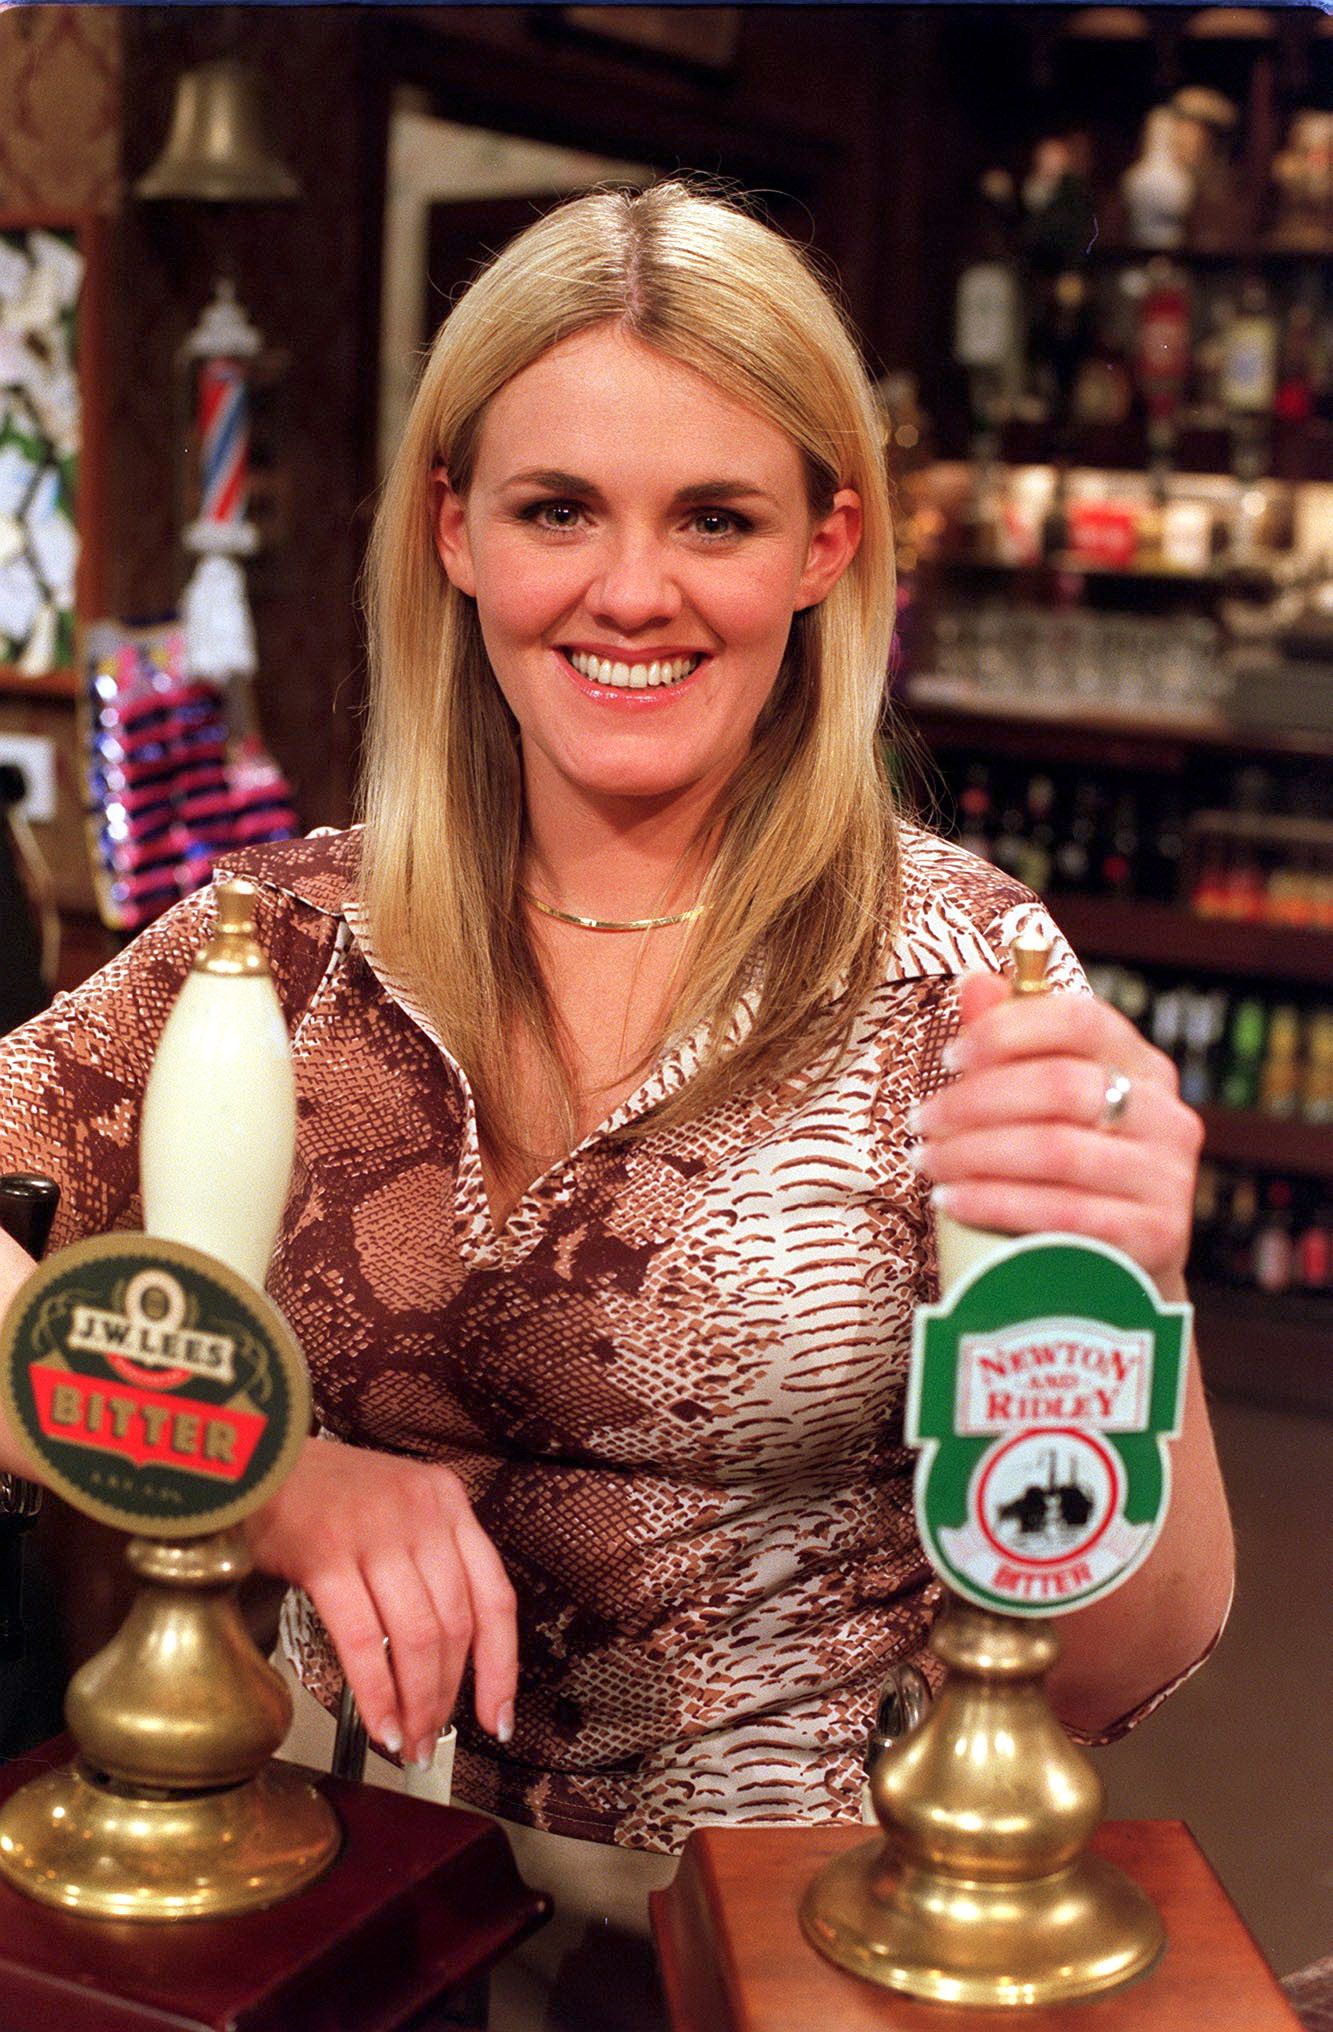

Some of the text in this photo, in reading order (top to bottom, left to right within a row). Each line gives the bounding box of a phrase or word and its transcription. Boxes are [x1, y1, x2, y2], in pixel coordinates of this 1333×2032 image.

[979, 1341, 1139, 1386] NEWTON
[1028, 1372, 1079, 1389] AND
[986, 1388, 1119, 1420] RIDLEY
[52, 1384, 237, 1465] BITTER
[991, 1562, 1093, 1597] BITTER
